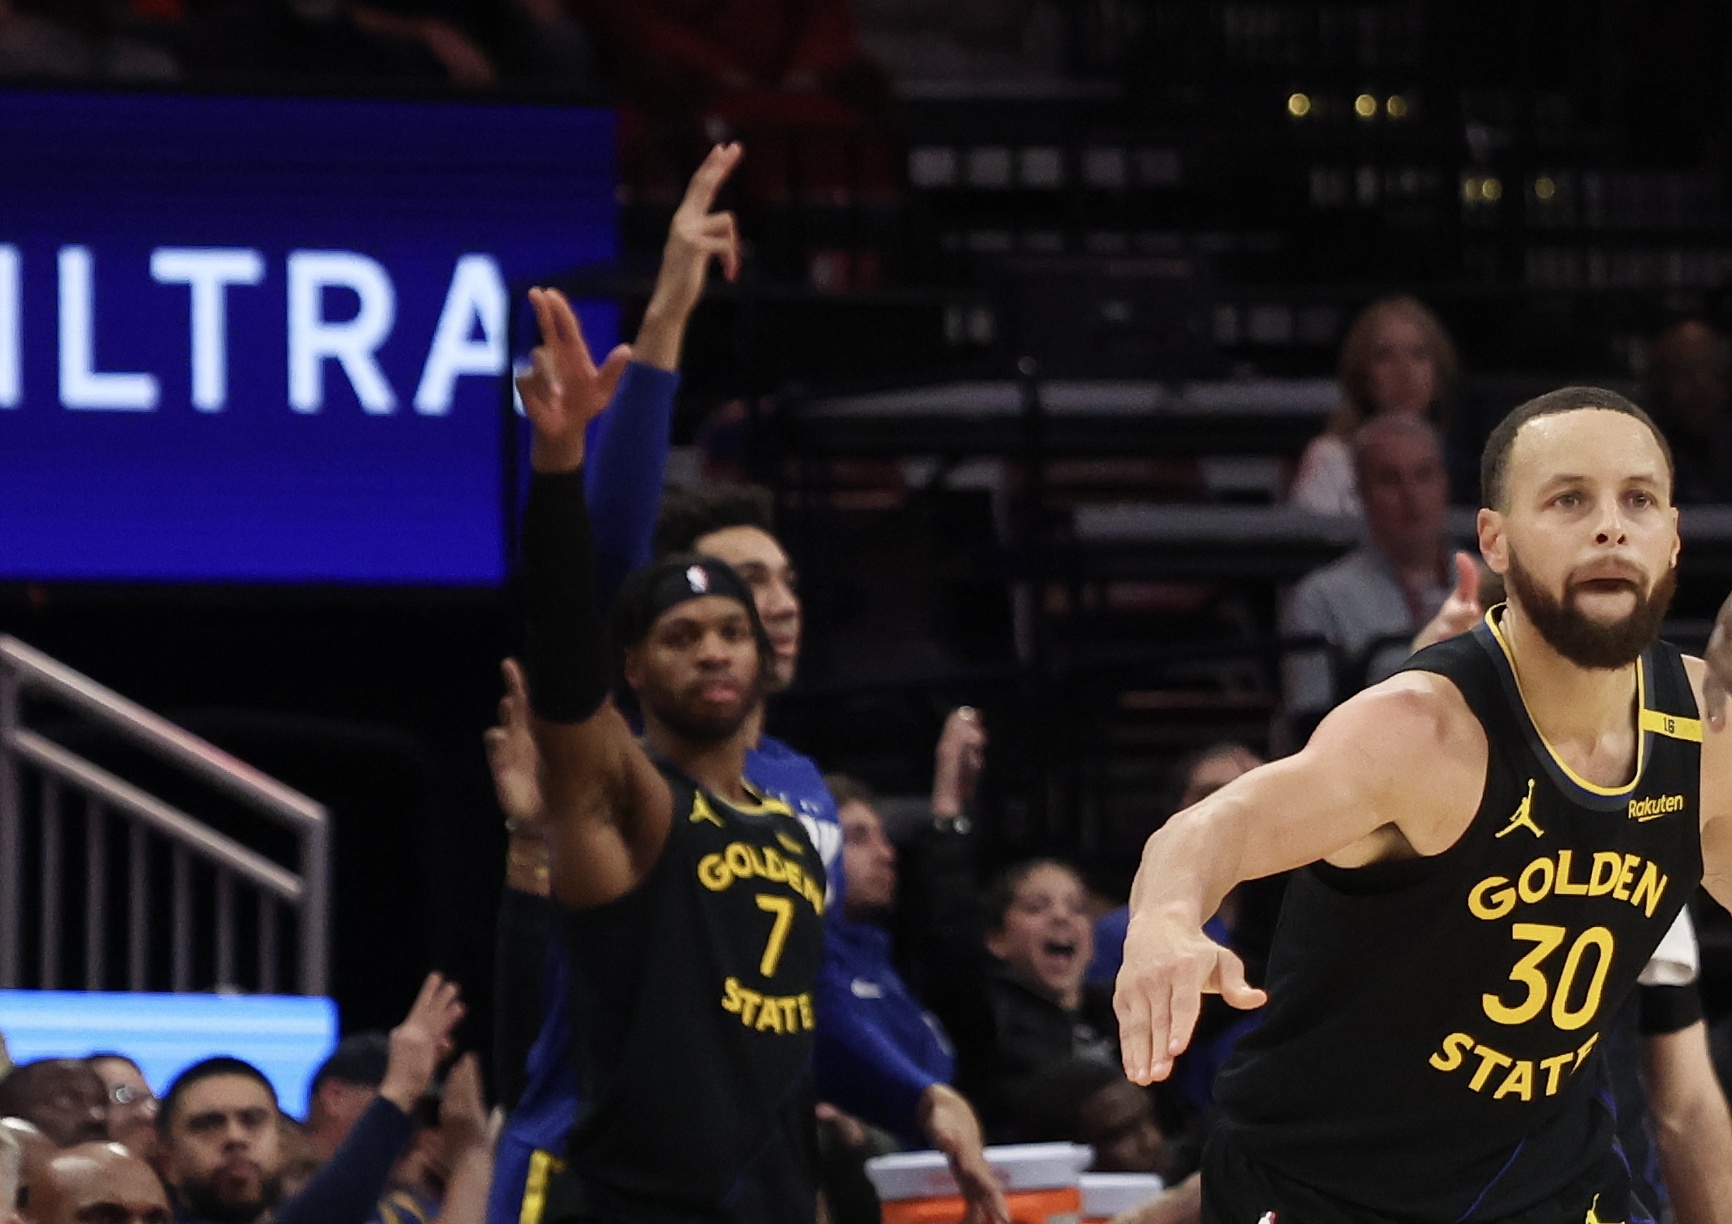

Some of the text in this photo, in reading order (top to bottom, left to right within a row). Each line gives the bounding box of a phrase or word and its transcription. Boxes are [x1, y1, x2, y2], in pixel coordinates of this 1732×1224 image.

[1628, 794, 1684, 820] Rakuten
[1467, 849, 1669, 921] GOLDEN
[754, 892, 798, 979] 7
[1482, 923, 1615, 1031] 30
